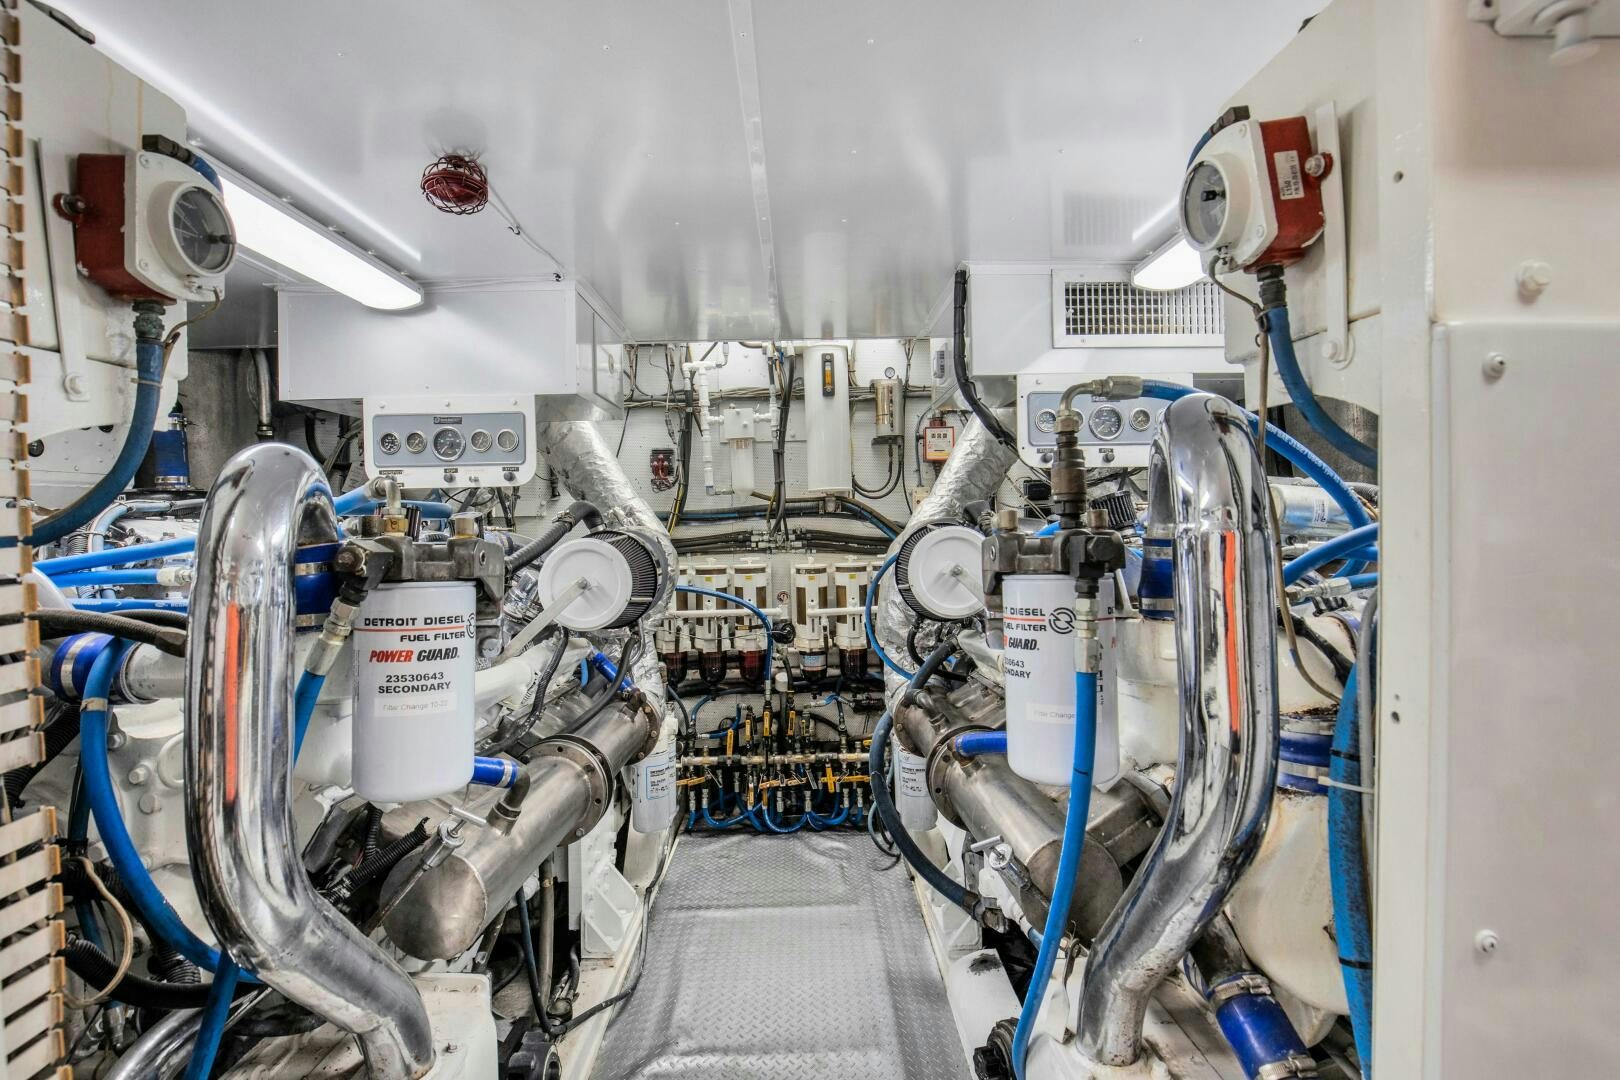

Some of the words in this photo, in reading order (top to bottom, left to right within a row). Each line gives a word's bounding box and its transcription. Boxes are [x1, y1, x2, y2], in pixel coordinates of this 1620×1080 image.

[1010, 607, 1045, 616] DIESEL
[364, 617, 417, 627] DETROIT
[424, 615, 465, 625] DIESEL
[1015, 624, 1047, 632] FILTER
[400, 634, 431, 642] FUEL
[434, 631, 466, 640] FILTER
[369, 650, 413, 663] POWER
[386, 672, 444, 683] 23530643
[378, 681, 451, 694] SECONDARY
